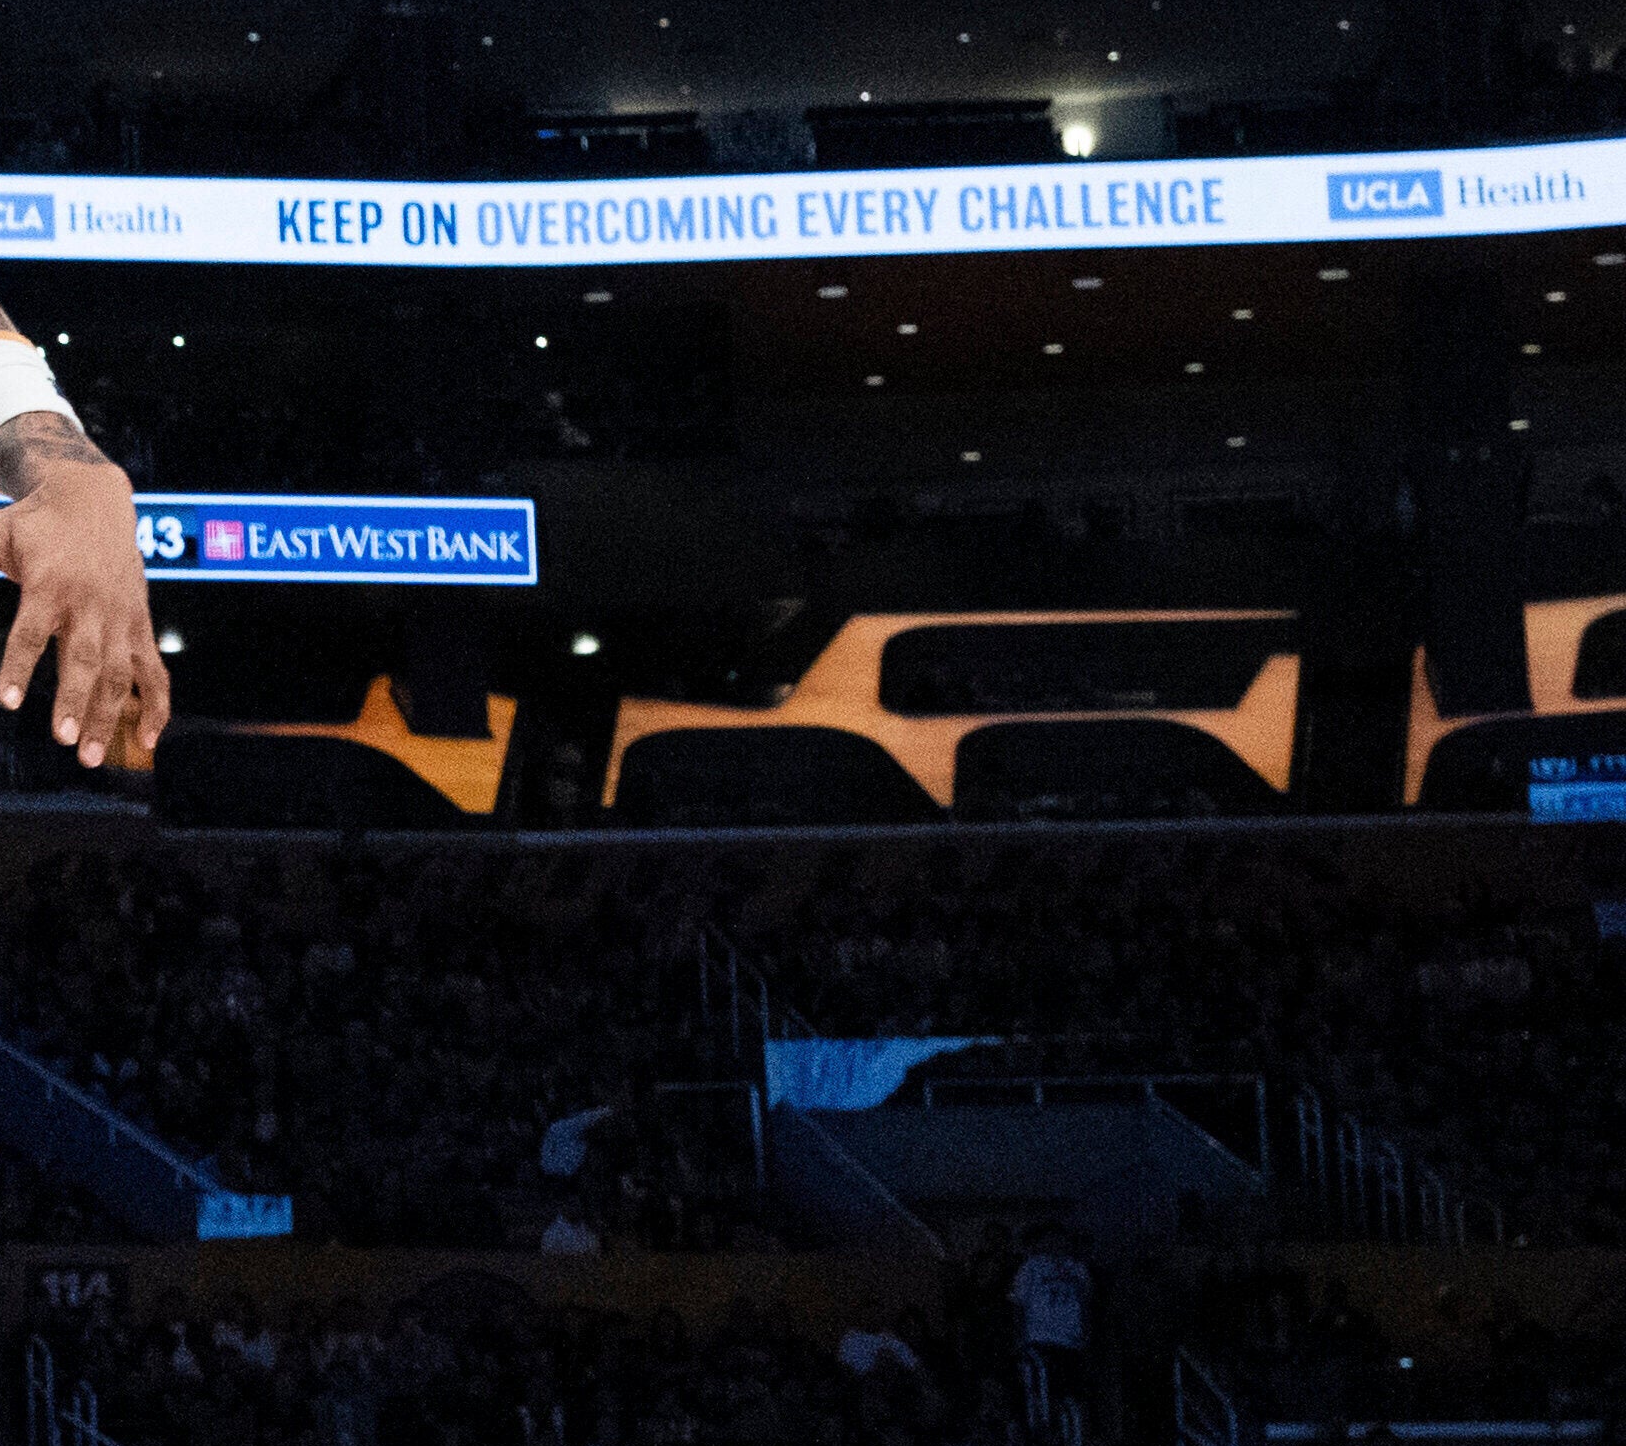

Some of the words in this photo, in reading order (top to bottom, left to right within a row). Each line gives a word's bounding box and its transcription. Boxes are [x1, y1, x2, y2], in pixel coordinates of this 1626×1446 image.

[1343, 183, 1429, 211] UCLA
[1457, 170, 1587, 209] Health
[68, 202, 184, 235] Health
[276, 198, 384, 247] KEEP
[401, 200, 459, 248] ON
[477, 193, 778, 247] OVERCOMING
[796, 188, 939, 238] EVERY
[958, 177, 1225, 233] CHALLENGE
[249, 521, 338, 559] EAST
[338, 524, 429, 561] WEST
[430, 526, 522, 563] BANK
